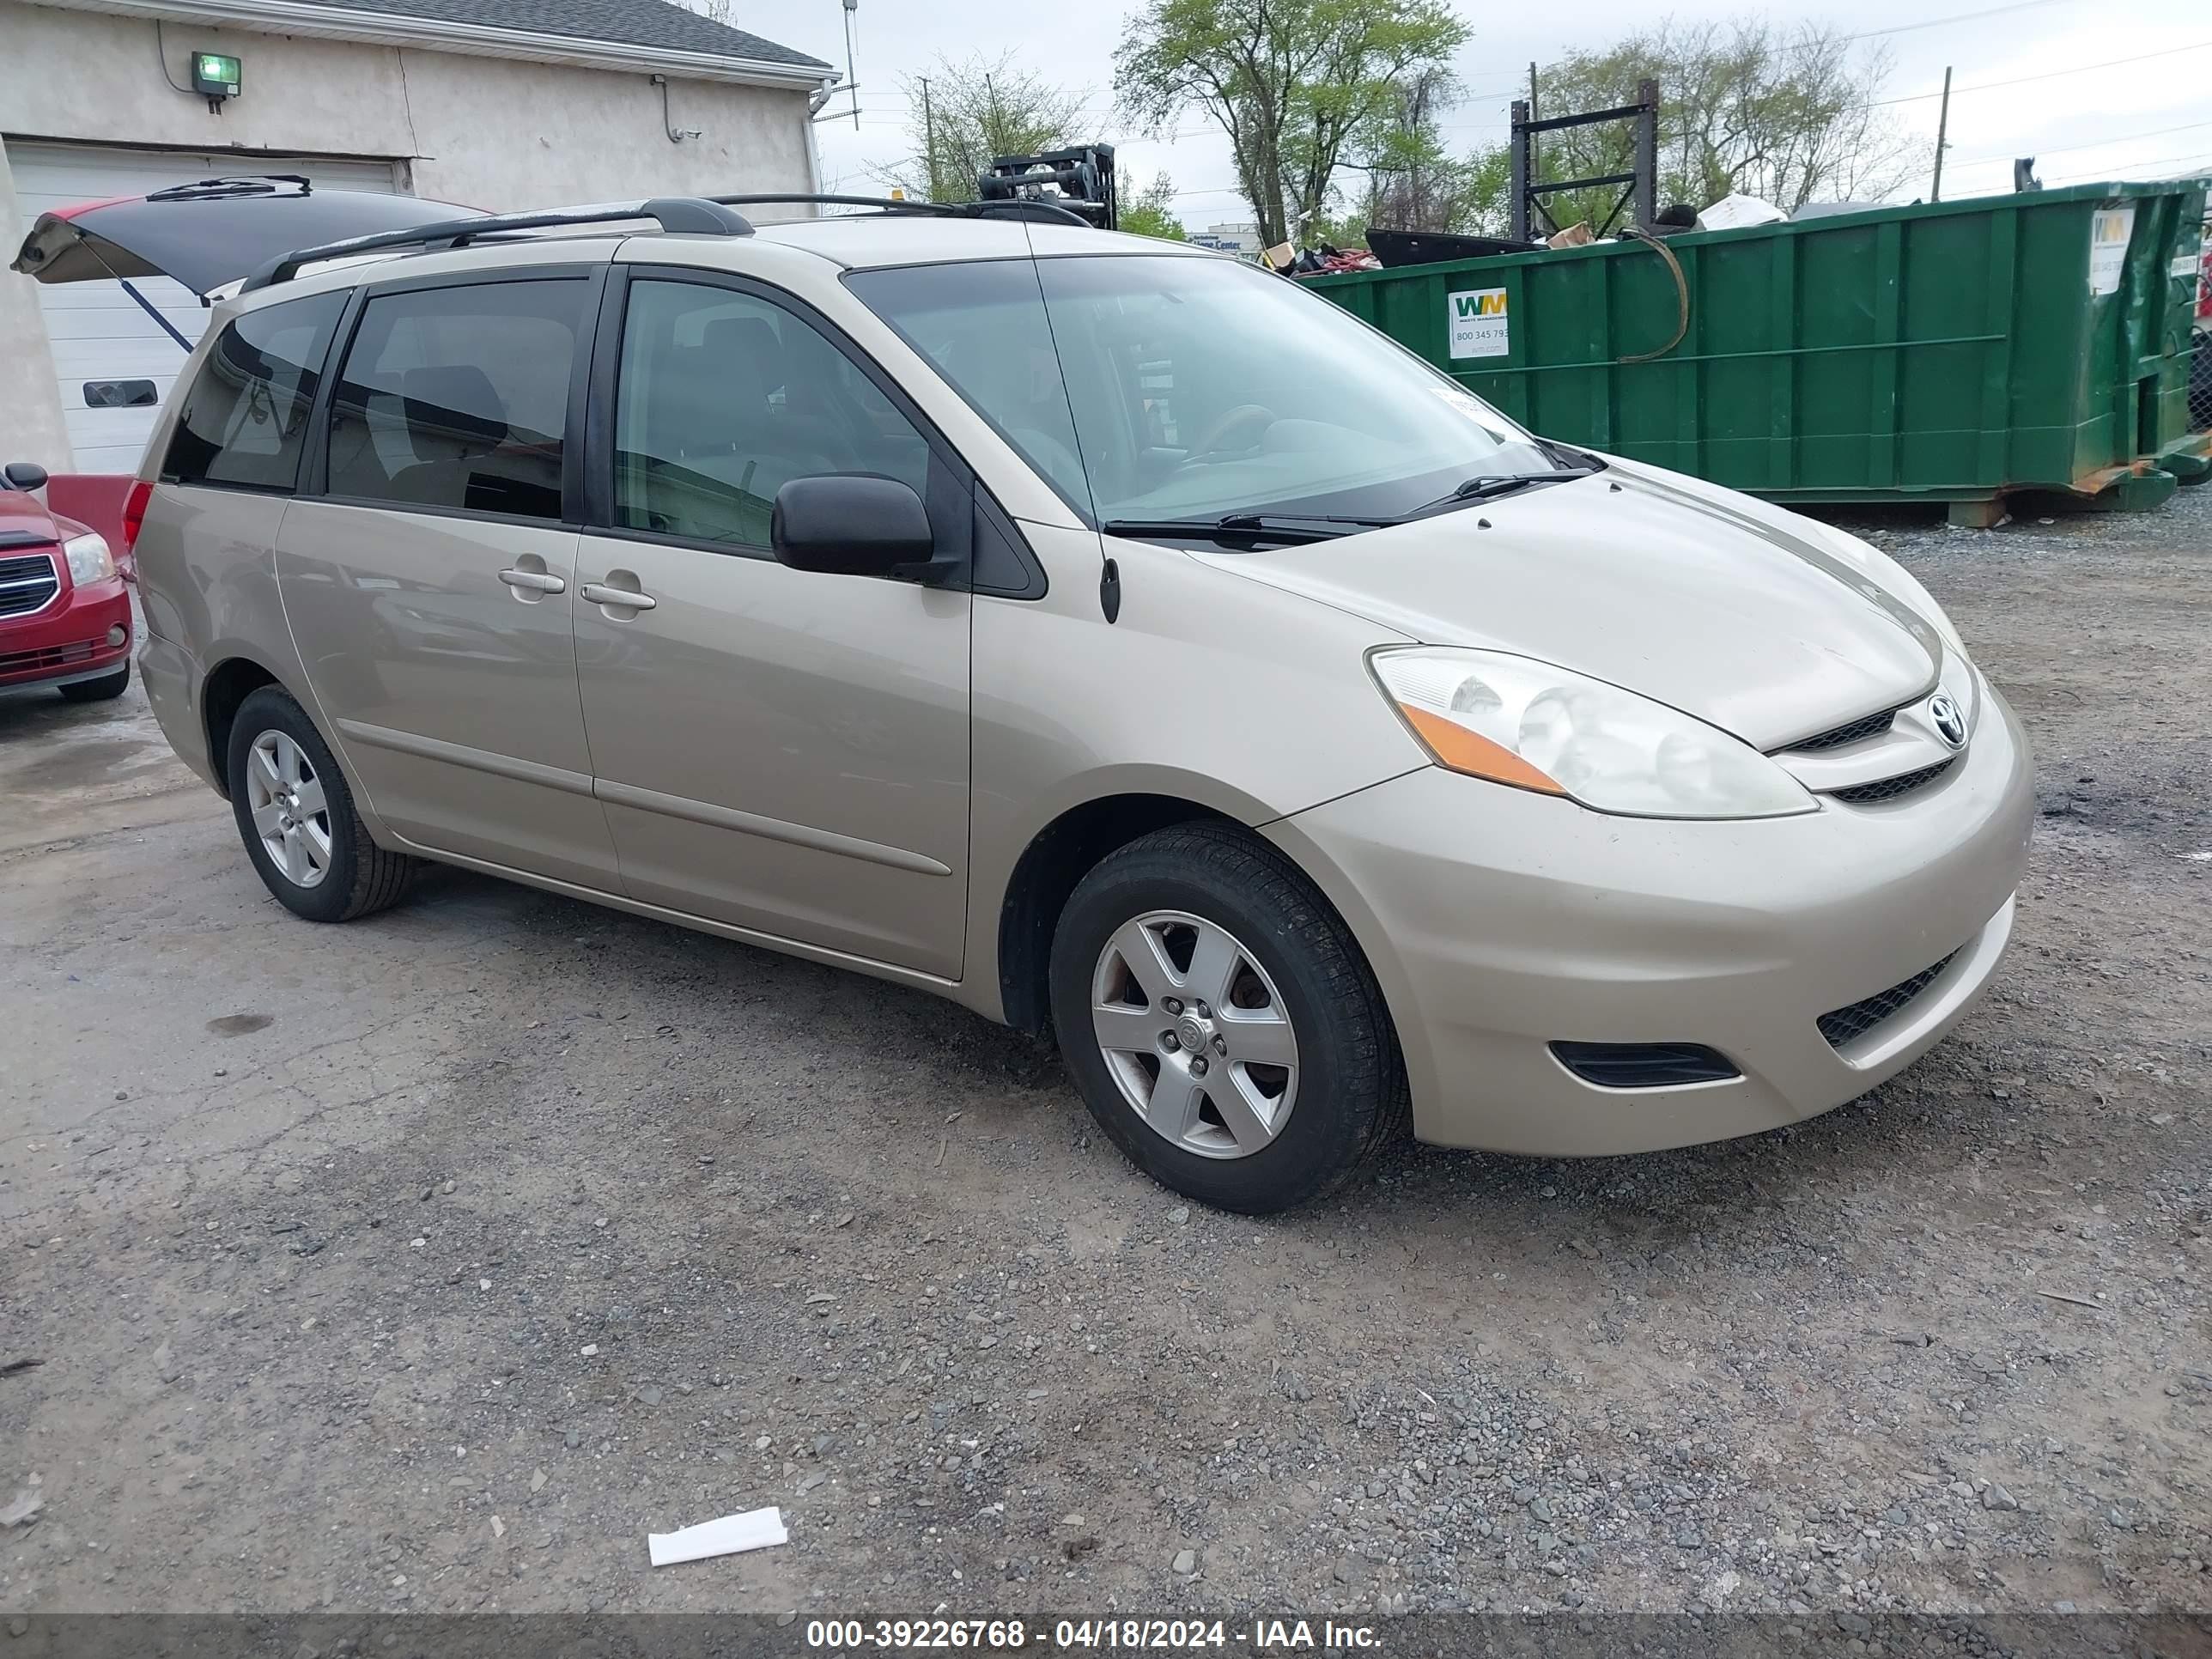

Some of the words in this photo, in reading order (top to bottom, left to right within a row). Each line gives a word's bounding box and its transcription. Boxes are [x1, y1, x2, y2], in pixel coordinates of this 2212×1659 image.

[1216, 240, 1241, 250] Center
[1455, 294, 1508, 317] WM
[1456, 331, 1474, 341] 800
[1475, 330, 1492, 339] 345
